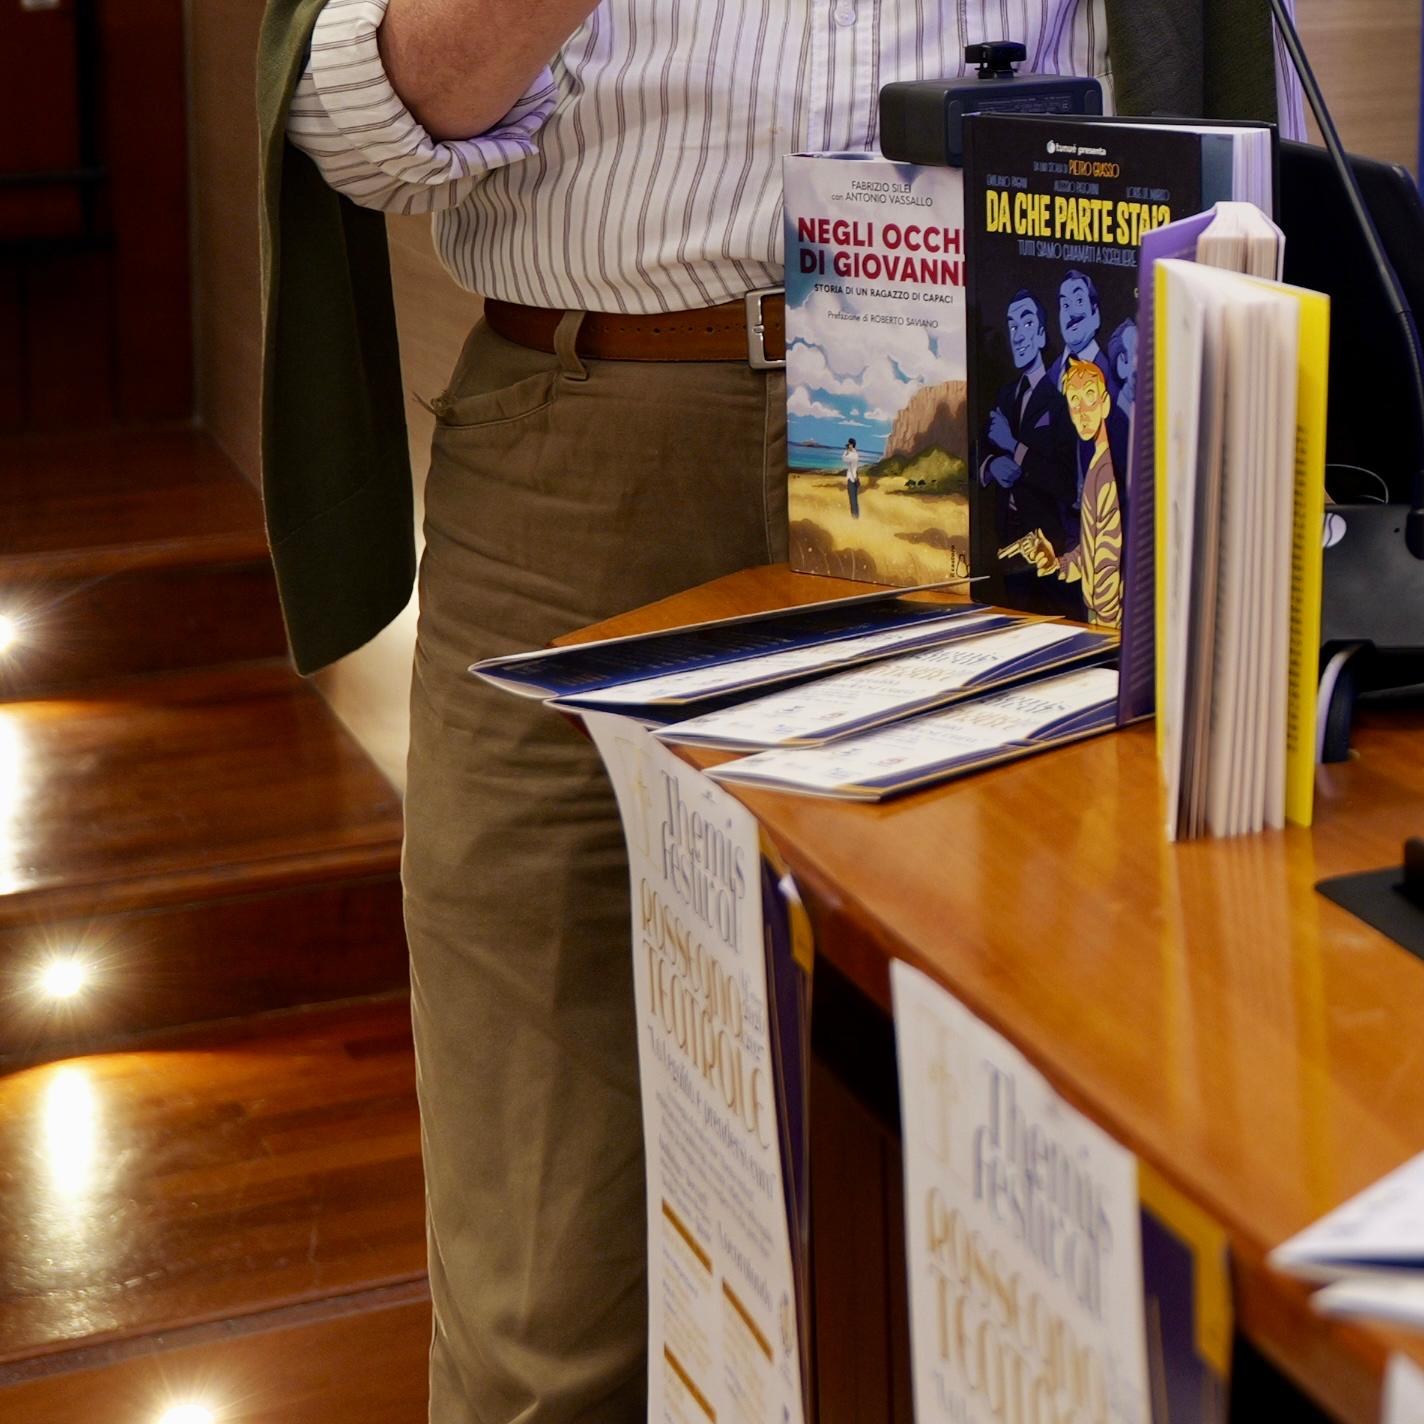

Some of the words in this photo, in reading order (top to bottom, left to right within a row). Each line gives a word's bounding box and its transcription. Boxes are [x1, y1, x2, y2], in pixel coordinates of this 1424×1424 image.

[1093, 161, 1120, 178] GRASSO
[852, 180, 889, 193] FABRIZIO
[892, 182, 911, 194] SILEI
[845, 192, 887, 204] ANTONIO
[889, 194, 933, 207] VASSALLO
[986, 189, 1012, 234] DA
[1014, 192, 1051, 237] CHE
[1054, 196, 1113, 243] PARTE
[798, 217, 873, 247] NEGLI
[882, 223, 965, 255] OCCH
[800, 249, 825, 275] DI
[1036, 241, 1061, 259] SIAMO
[1062, 243, 1095, 263] CHIAMATI
[1096, 246, 1102, 263] A
[1102, 247, 1138, 268] SCEGLIERE
[814, 283, 843, 294] STORIA
[845, 287, 854, 295] DI
[855, 287, 868, 297] UN
[870, 288, 910, 300] RAGAZZO
[911, 291, 921, 301] DI
[923, 292, 953, 304] CAPACI
[827, 311, 861, 322] Prefazione
[862, 313, 869, 322] di
[870, 314, 904, 326] ROBERTO
[906, 317, 939, 329] SAVIANO
